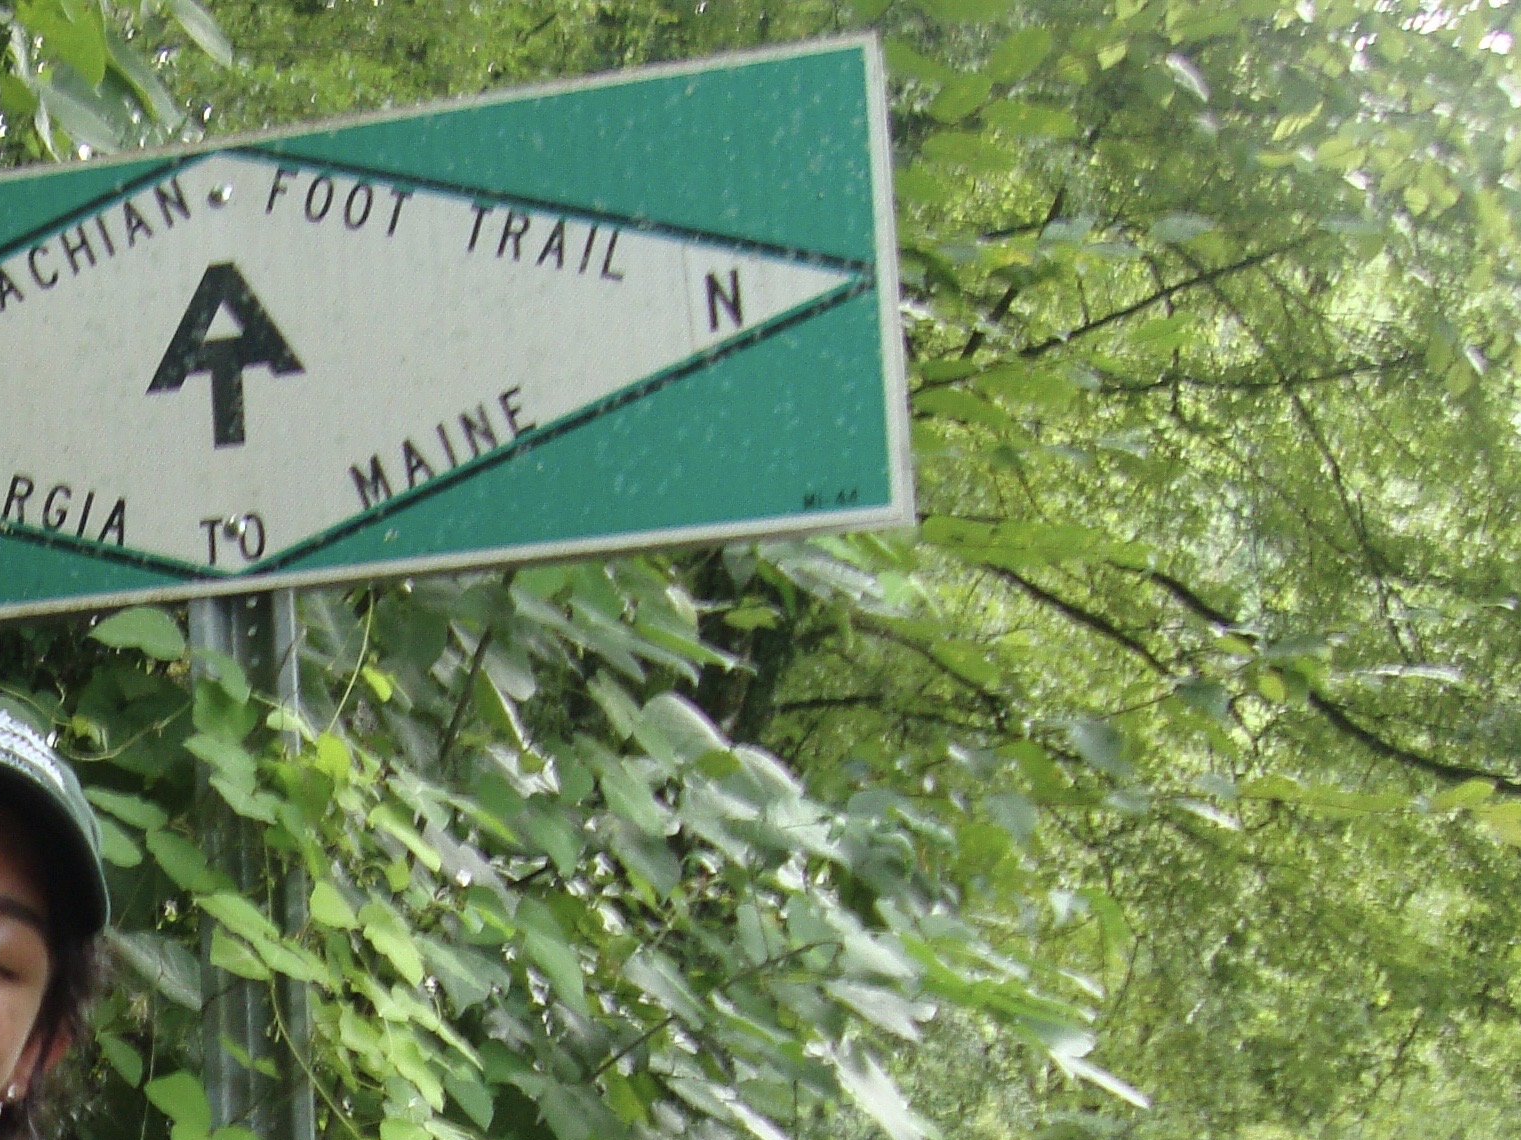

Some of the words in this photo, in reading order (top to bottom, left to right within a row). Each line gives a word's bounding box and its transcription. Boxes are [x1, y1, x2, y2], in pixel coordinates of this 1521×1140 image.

[265, 168, 412, 238] FOOT
[466, 204, 625, 281] TRAIL
[703, 268, 746, 333] N
[198, 513, 266, 568] TO
[348, 386, 538, 510] MAINE
